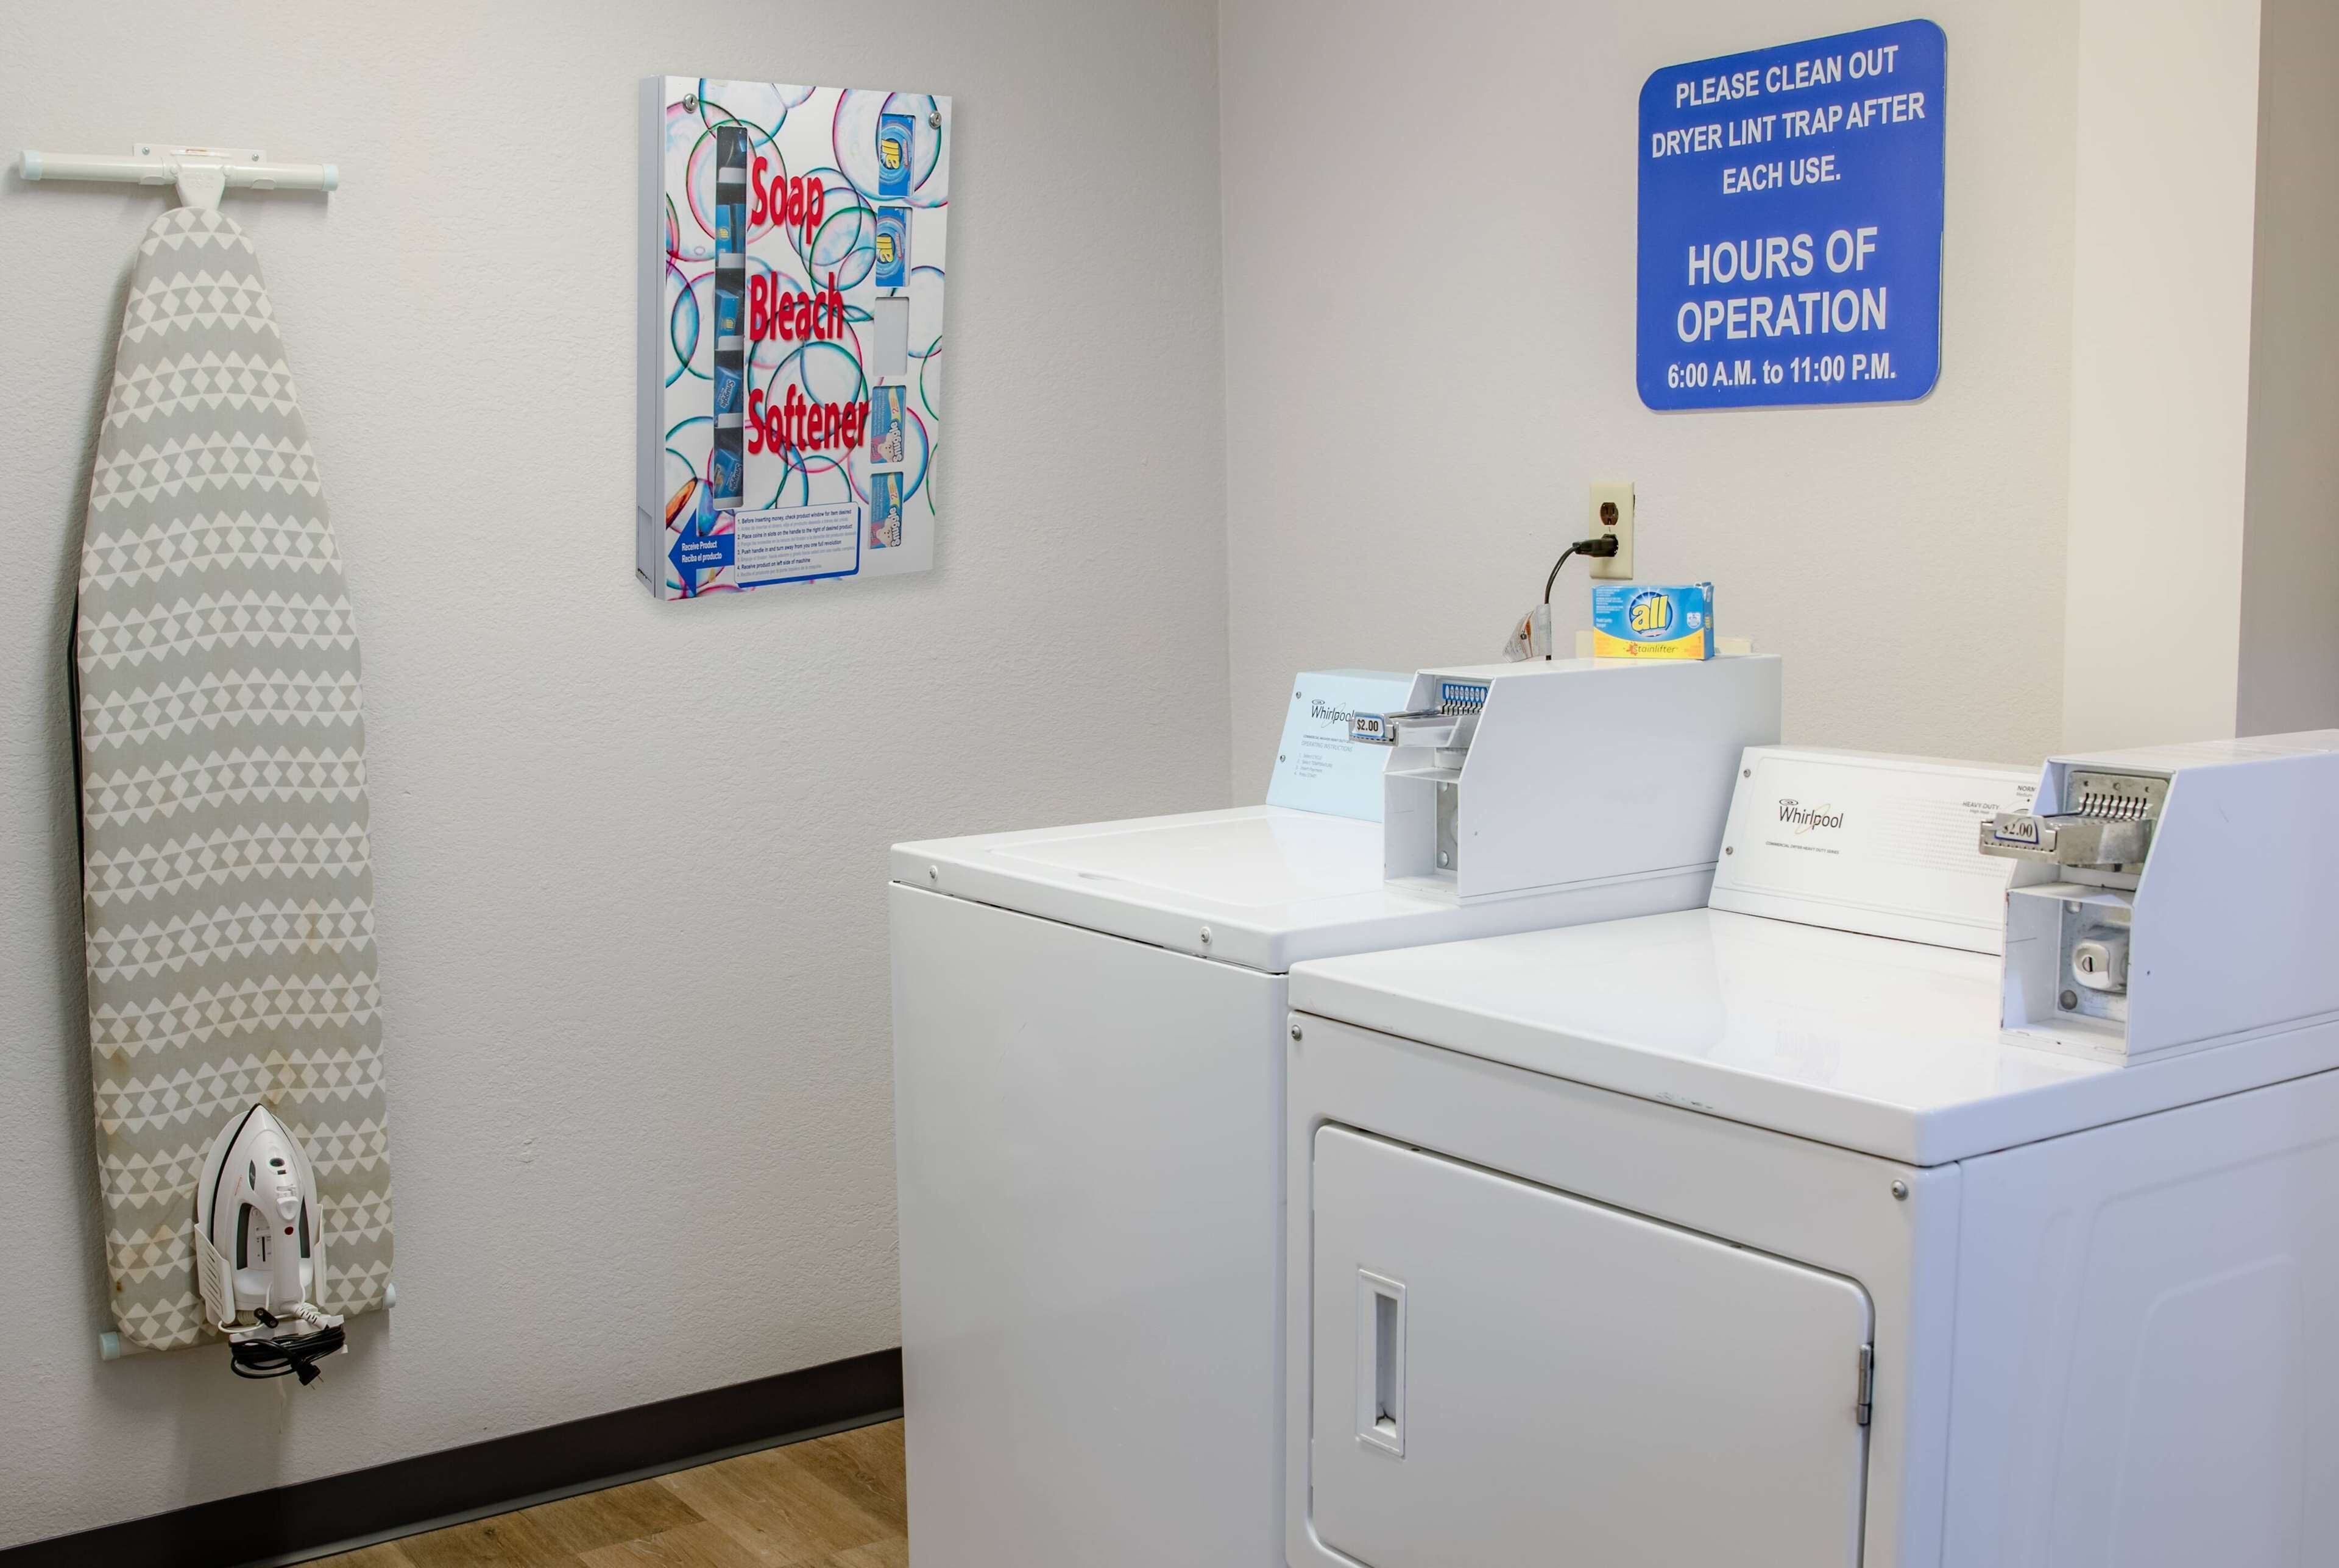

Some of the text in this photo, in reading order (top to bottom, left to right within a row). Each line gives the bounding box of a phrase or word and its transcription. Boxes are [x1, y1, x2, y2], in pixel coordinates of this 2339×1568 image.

[1676, 45, 1898, 108] PLEASE CLEAN OUT
[1652, 93, 1925, 158] DRYER LINT TRAP AFTER
[882, 139, 899, 169] all
[1723, 155, 1841, 194] EACH USE.
[751, 156, 824, 244] Soap
[877, 236, 893, 263] all
[1688, 226, 1878, 286] HOURS OF
[749, 272, 844, 341] Bleach
[1677, 287, 1886, 342] OPERATION
[1668, 353, 1896, 388] 6:00 A.M. to 11:00 P.M.
[721, 380, 735, 407] Snuggle
[748, 384, 869, 454] Softener
[890, 422, 902, 462] Snuggle
[888, 507, 901, 546] Snuggle
[682, 541, 717, 551] Receive Product
[682, 554, 697, 563] Reciba
[702, 552, 722, 563] producto
[1632, 595, 1669, 632] all
[1311, 705, 1354, 724] Whirlpool
[1357, 719, 1379, 732] $2.00
[1780, 805, 1844, 830] Whirlpool
